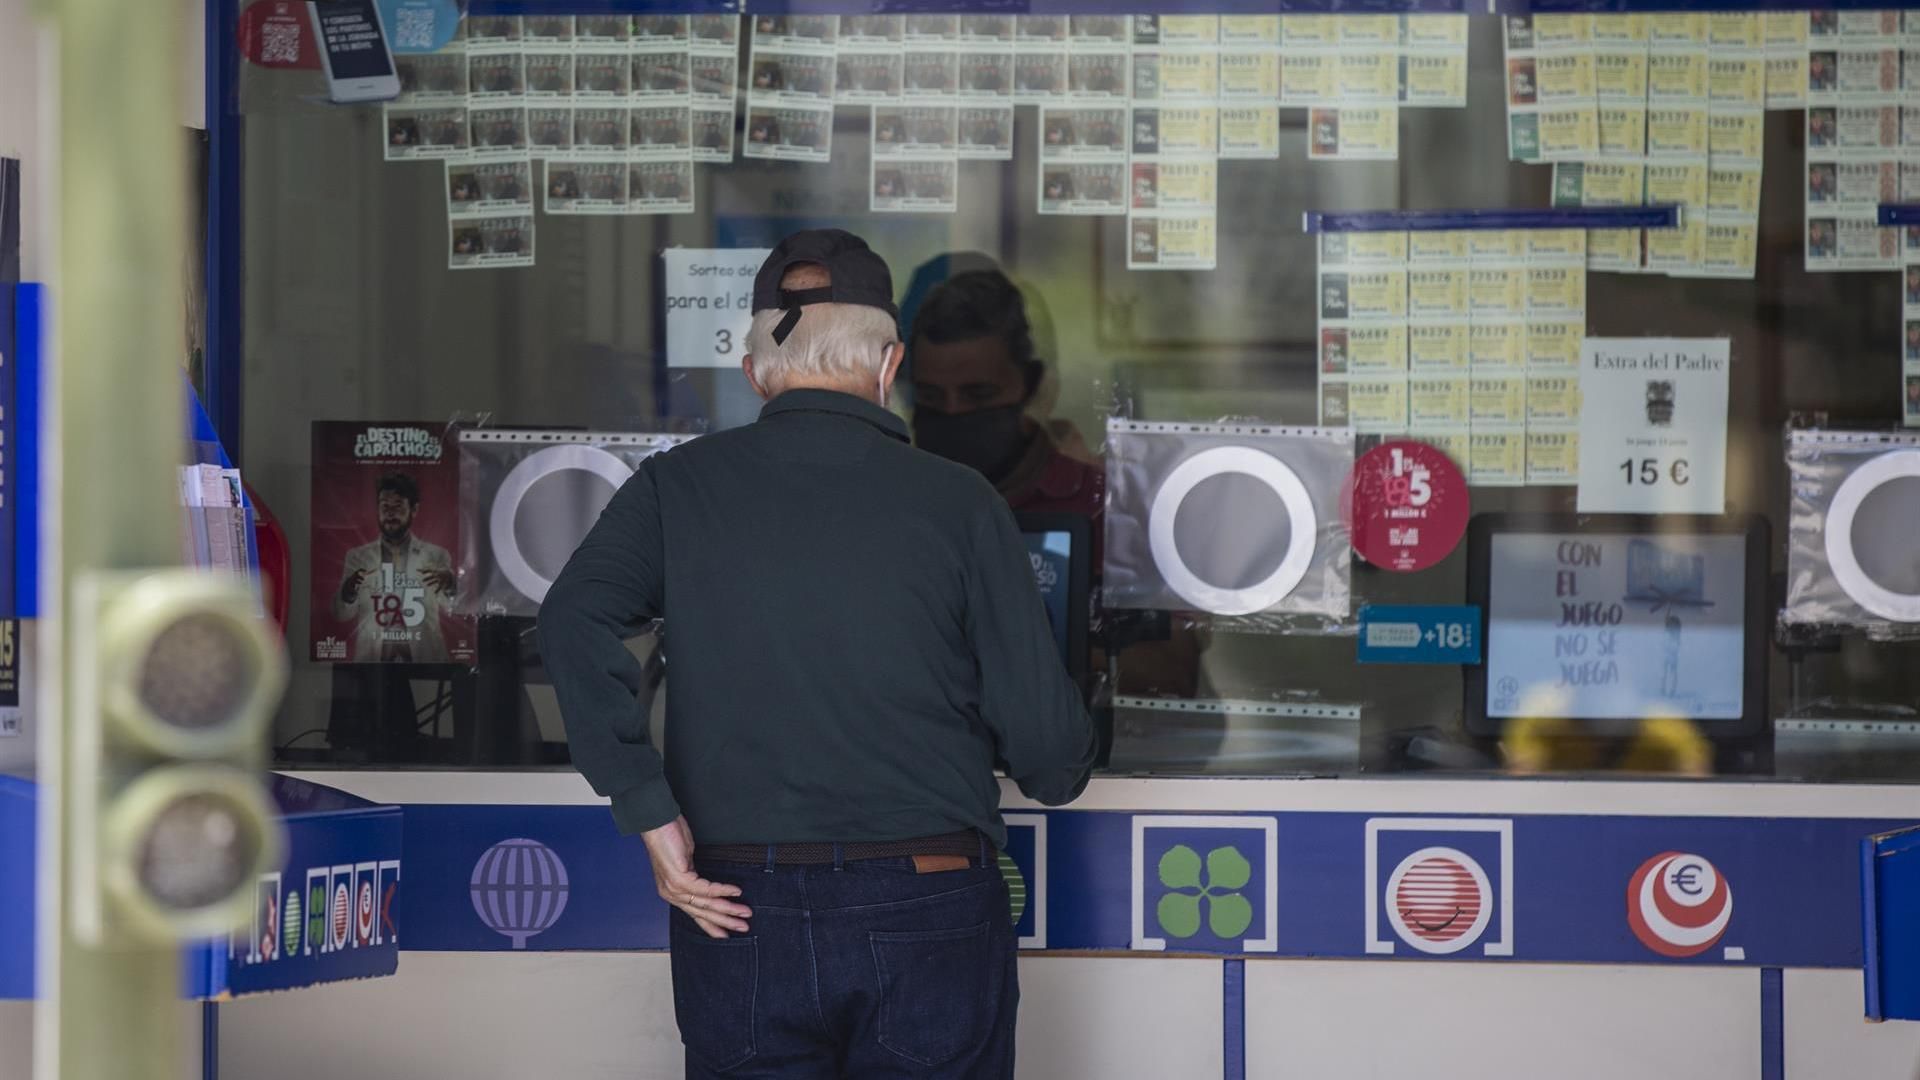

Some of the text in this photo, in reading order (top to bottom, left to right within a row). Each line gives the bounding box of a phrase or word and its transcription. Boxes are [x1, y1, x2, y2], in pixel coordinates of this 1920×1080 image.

[688, 264, 734, 276] Sorteo
[666, 296, 708, 313] para
[713, 291, 730, 309] el
[715, 329, 733, 354] 3
[1594, 352, 1723, 371] Extra del Padre
[367, 427, 429, 443] DESTINO
[354, 441, 442, 460] CAPRICHOSO
[1391, 448, 1403, 477] 1
[1620, 459, 1689, 485] 15 €
[1411, 469, 1432, 506] 5
[1557, 540, 1602, 566] CON
[382, 562, 393, 592] 1
[1556, 571, 1579, 598] EL
[403, 588, 425, 627] 5
[1557, 602, 1623, 628] JUEGO
[1425, 623, 1465, 648] +18
[1556, 631, 1617, 658] NO SE
[1557, 661, 1619, 688] JUEGA
